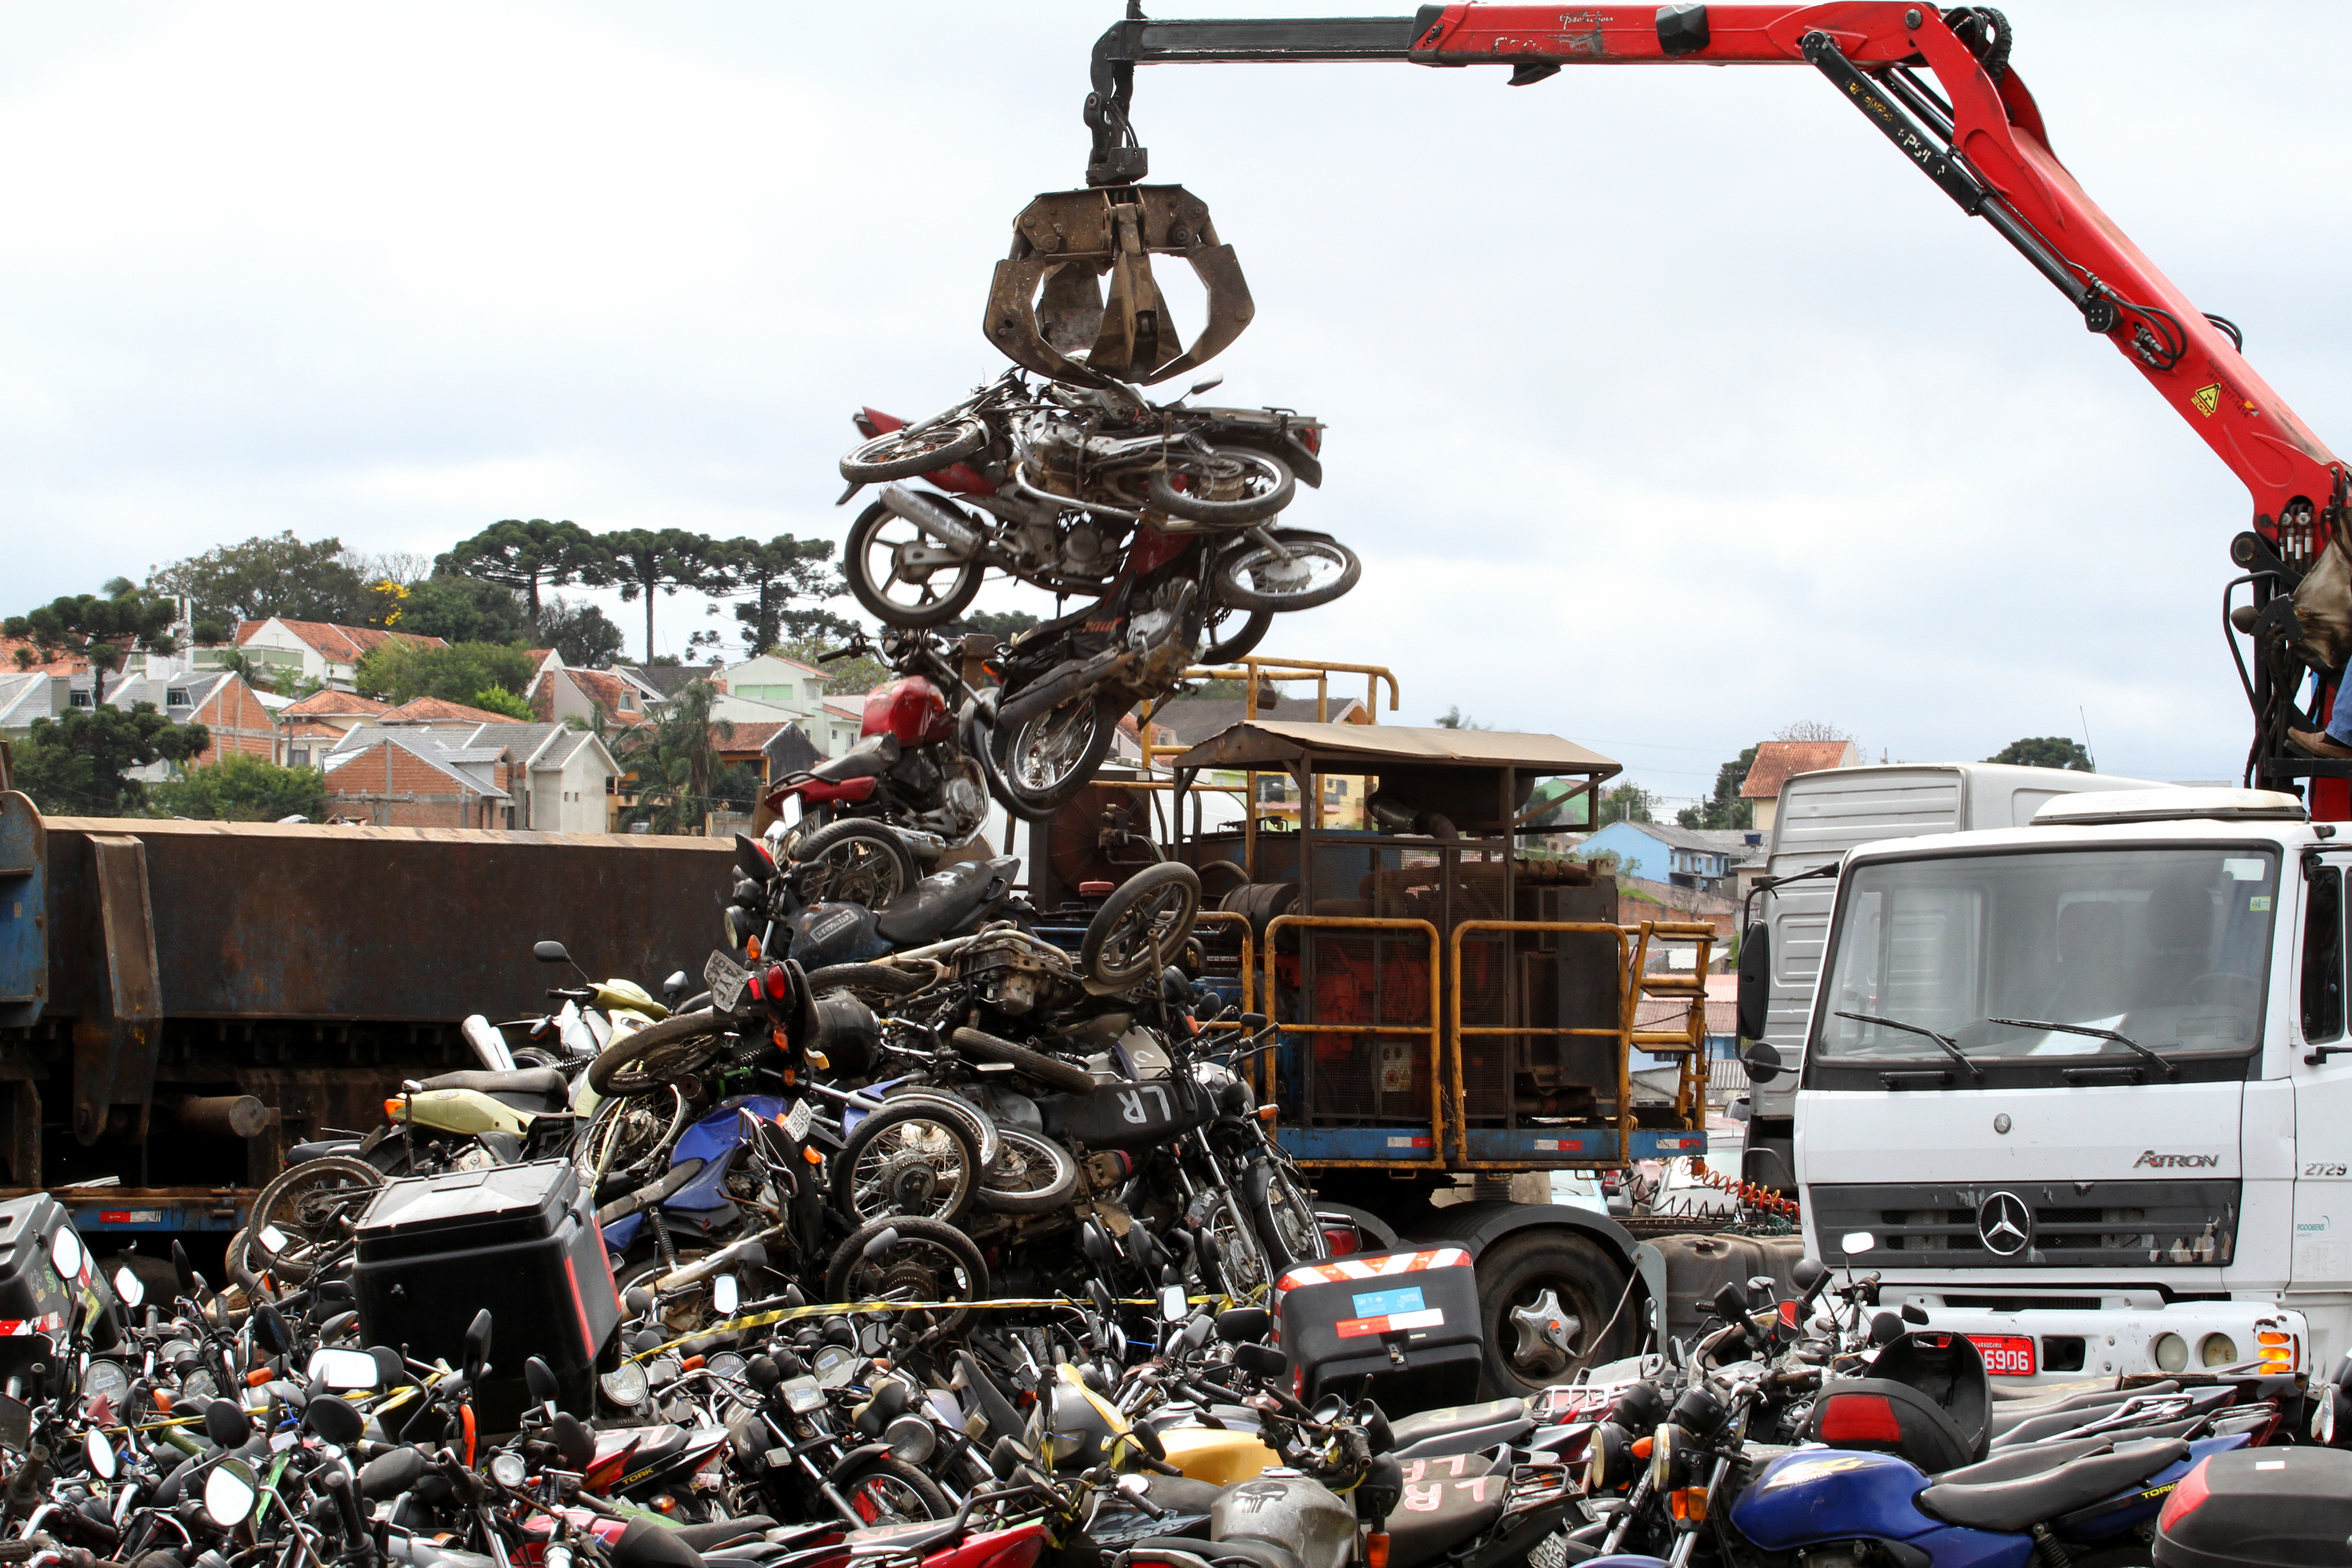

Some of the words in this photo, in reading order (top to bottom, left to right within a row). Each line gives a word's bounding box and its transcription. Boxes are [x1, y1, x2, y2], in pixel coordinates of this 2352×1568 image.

[2304, 1162, 2347, 1176] 2729
[1984, 1350, 2029, 1371] 6906
[622, 1467, 653, 1485] TORK
[2141, 1483, 2176, 1499] TORK
